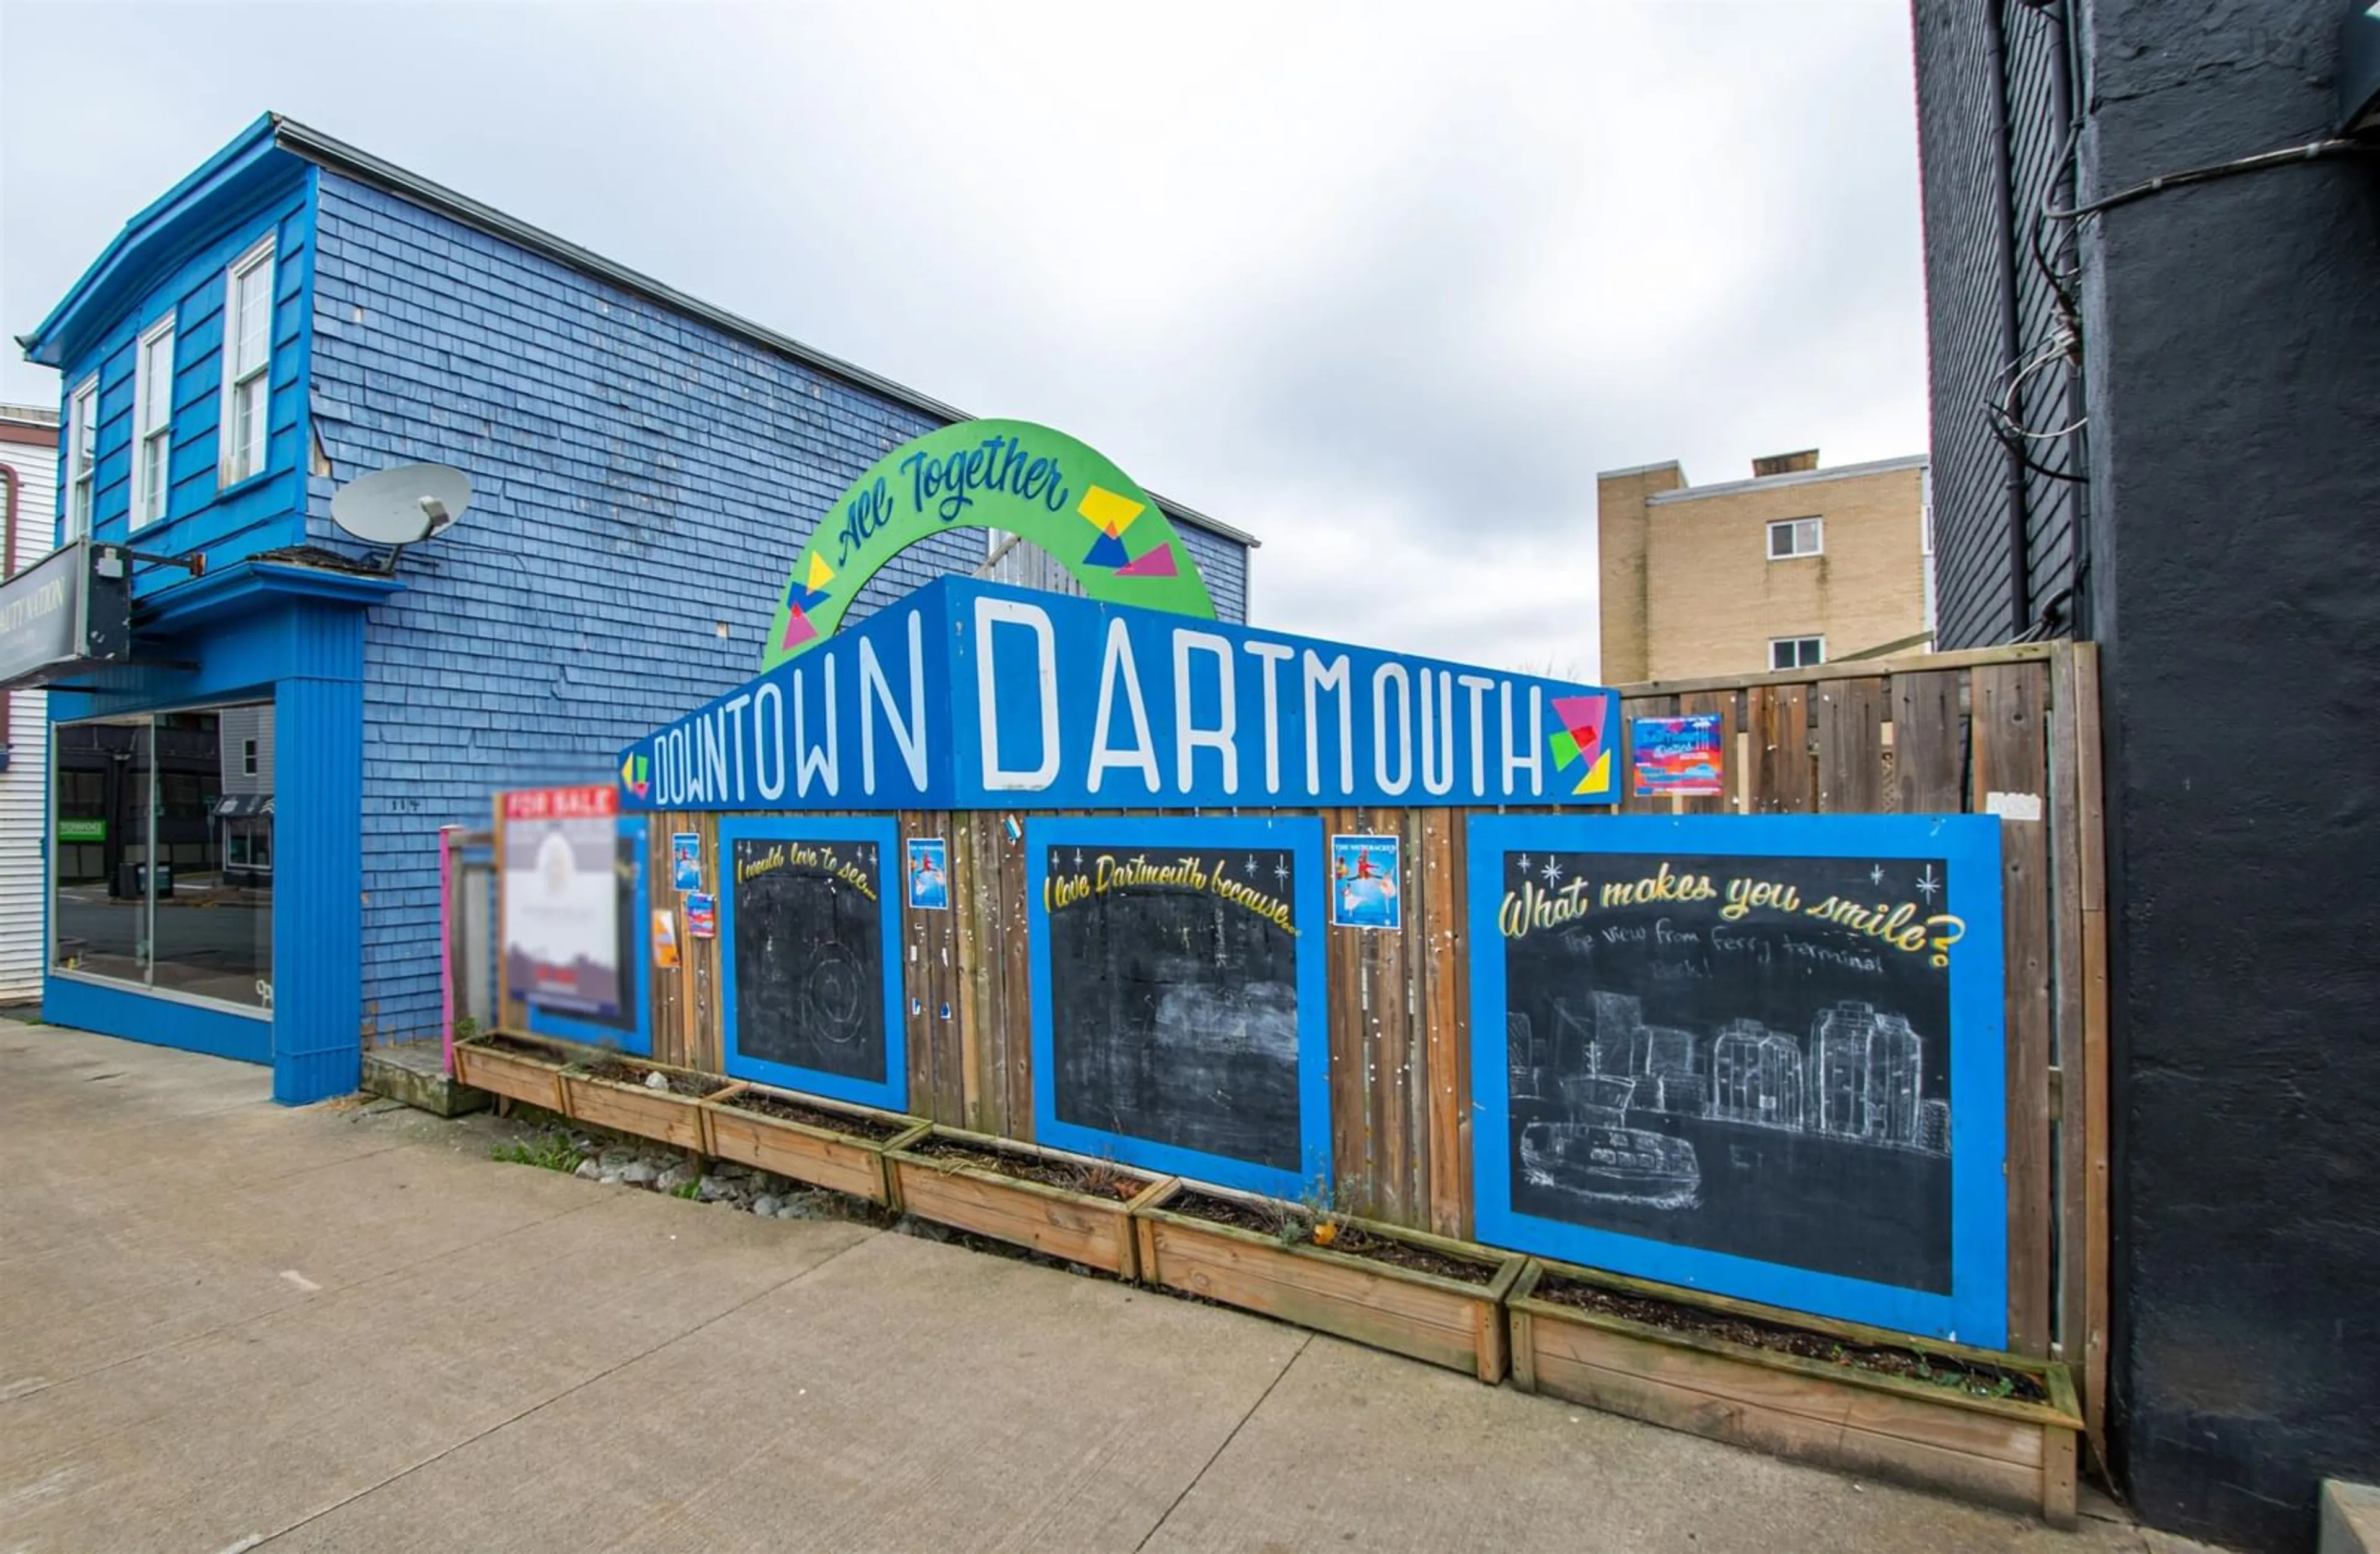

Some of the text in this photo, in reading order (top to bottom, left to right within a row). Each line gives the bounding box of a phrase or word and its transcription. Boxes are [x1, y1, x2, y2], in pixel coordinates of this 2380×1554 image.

[839, 435, 1069, 567] All Together
[654, 597, 1545, 805] DOWNTOWN DARTMOUTH
[738, 859, 743, 884] I
[746, 845, 784, 879] would
[791, 842, 818, 867] love
[1044, 877, 1051, 913] I
[1056, 872, 1089, 908] love
[1096, 854, 1206, 893] Dartmouth
[1498, 863, 1966, 968] What makes you smile?
